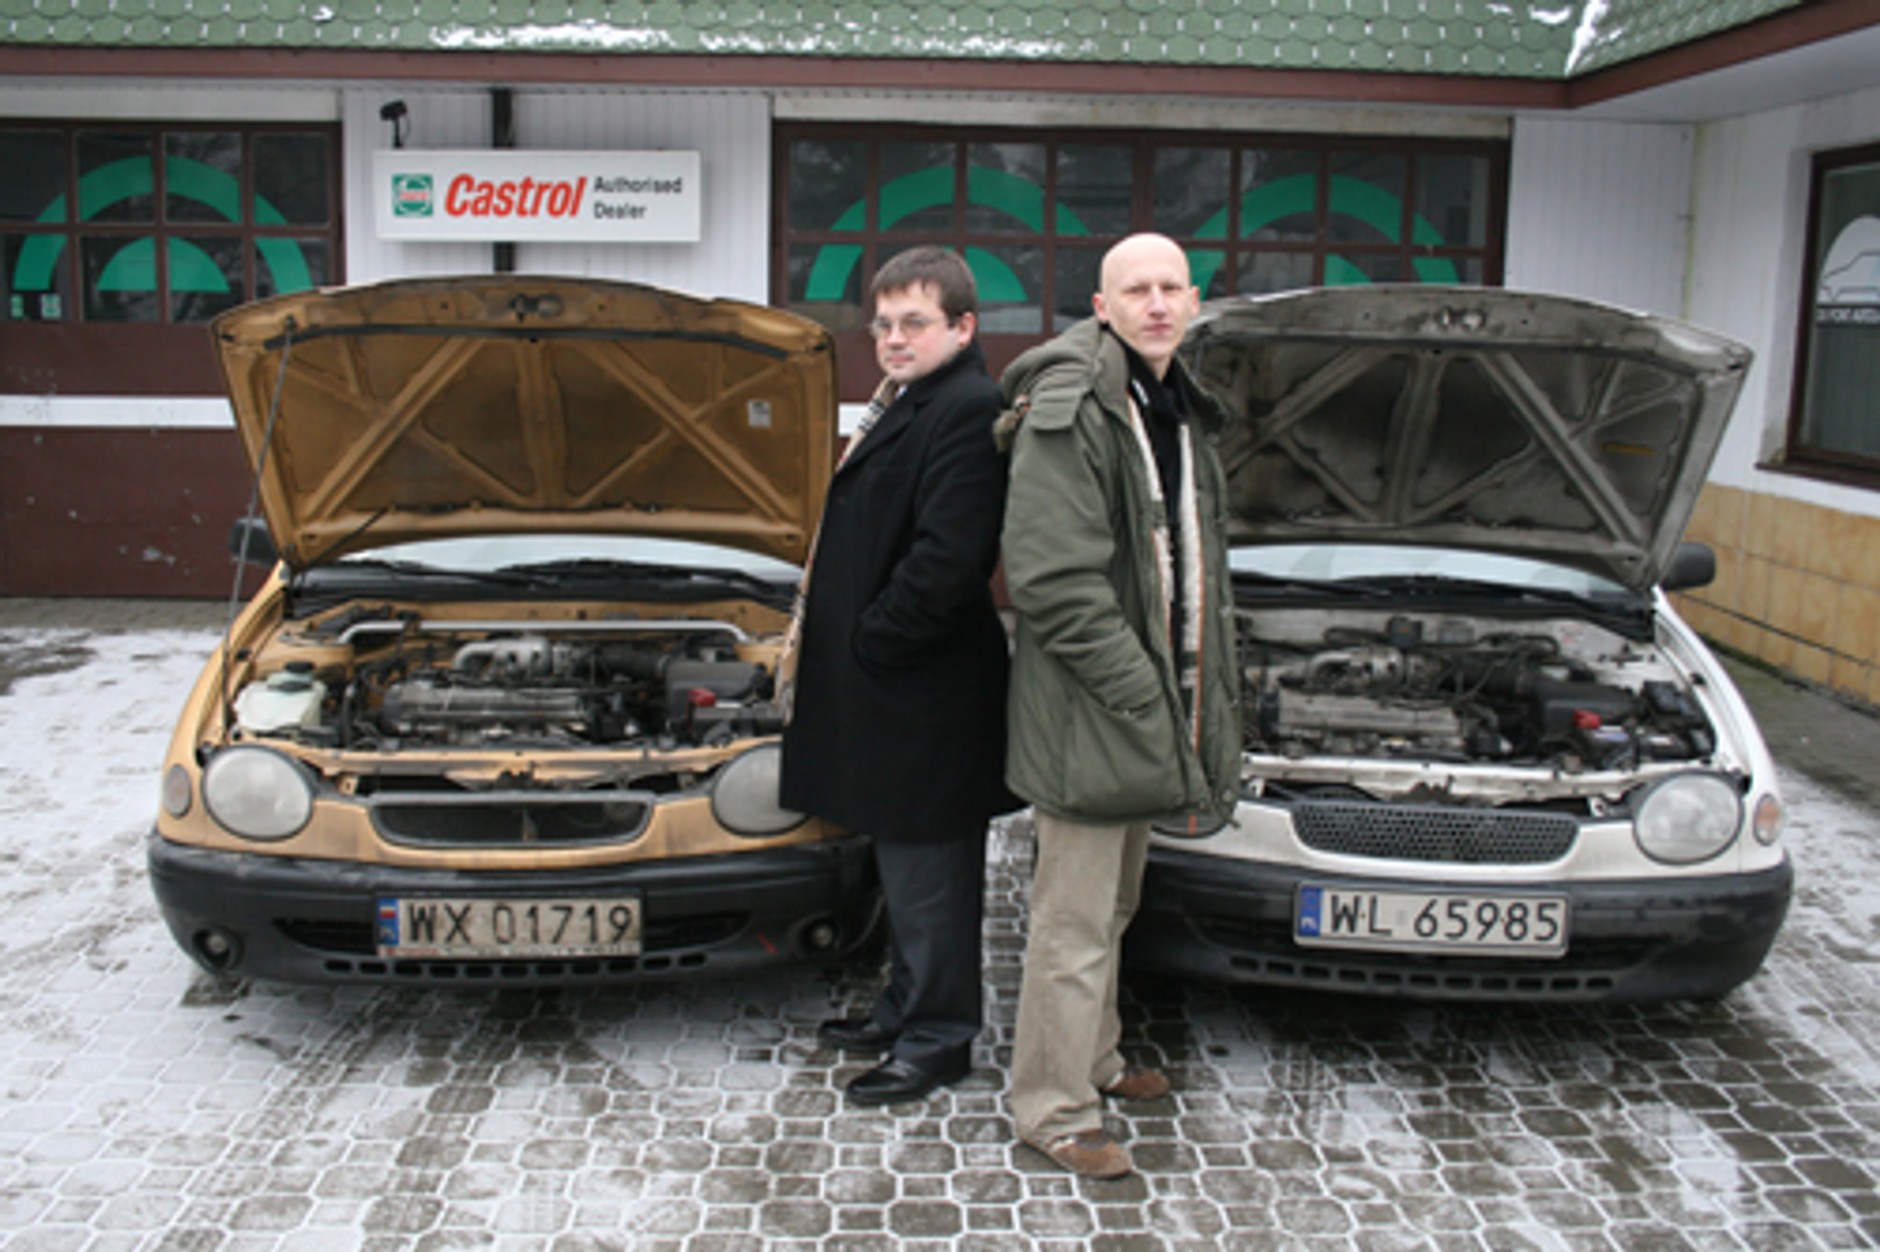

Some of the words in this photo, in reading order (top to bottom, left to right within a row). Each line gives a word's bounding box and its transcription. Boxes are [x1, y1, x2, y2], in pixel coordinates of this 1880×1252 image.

[444, 173, 587, 217] Castrol
[594, 177, 682, 194] Authorised
[594, 203, 646, 219] Dealer
[408, 903, 471, 944] WX
[492, 903, 633, 944] 01719
[1330, 894, 1392, 937] WL
[1414, 898, 1558, 942] 65985
